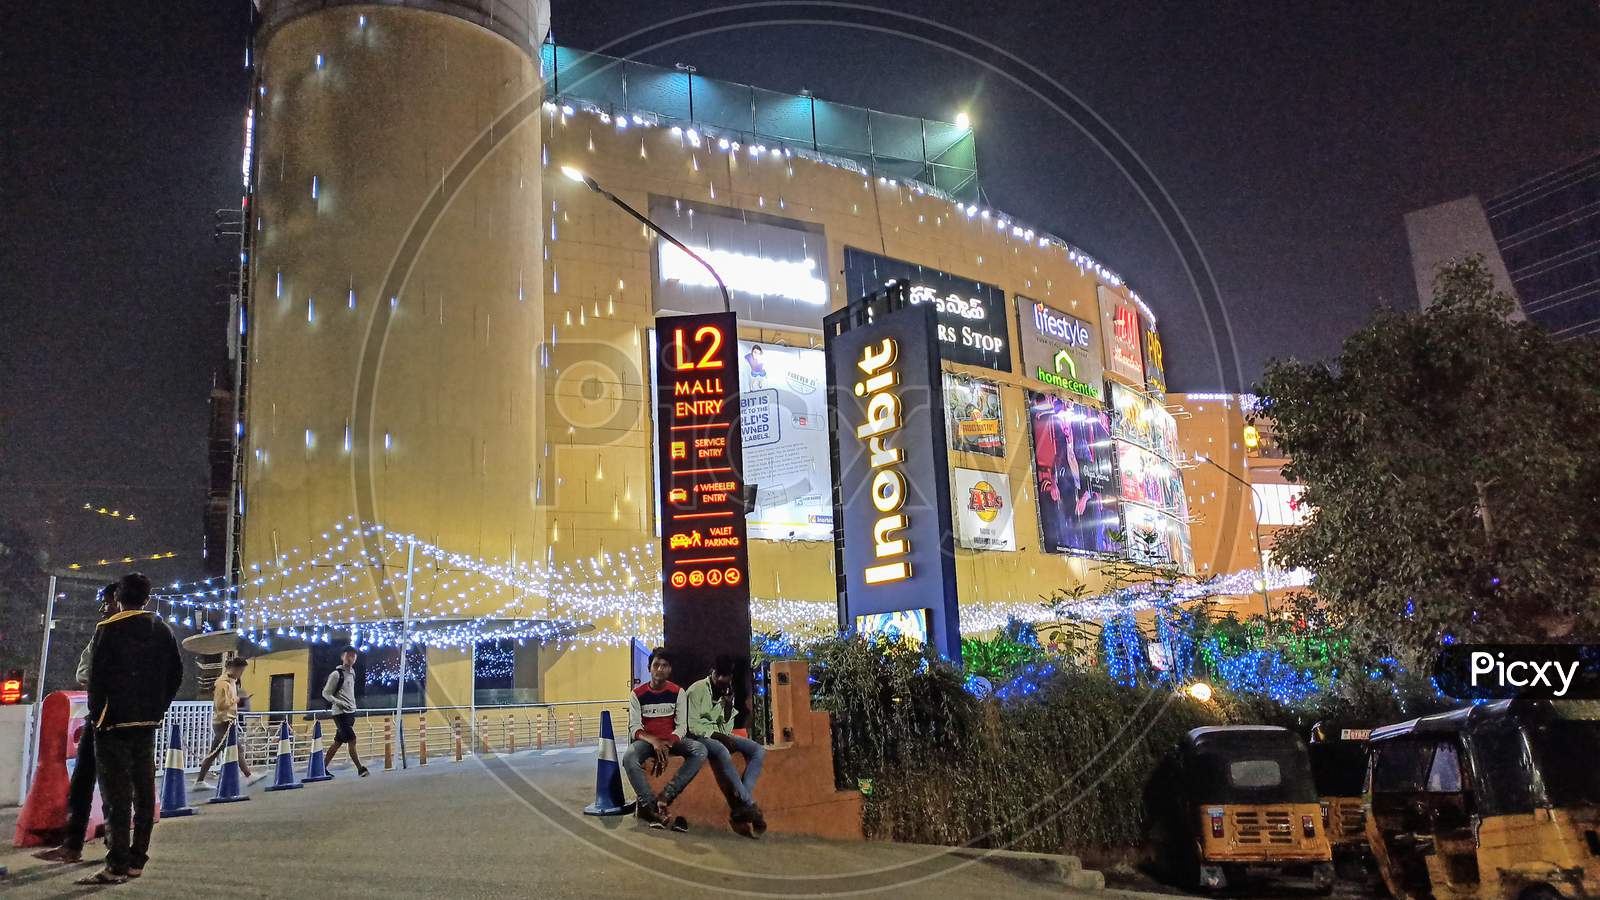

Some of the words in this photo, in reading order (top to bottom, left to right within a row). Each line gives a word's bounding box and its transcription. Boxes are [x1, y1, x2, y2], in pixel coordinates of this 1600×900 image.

[1032, 302, 1089, 347] lifestyle
[937, 324, 957, 343] RS
[961, 325, 1003, 353] STOP
[674, 326, 723, 370] L2
[674, 378, 723, 396] MALL
[1037, 366, 1099, 398] homecentre
[759, 396, 768, 405] IS
[675, 399, 723, 417] ENTRY
[748, 407, 756, 415] TO
[757, 405, 768, 413] THE
[694, 437, 726, 448] SERVICE
[699, 448, 723, 458] ENTRY
[857, 337, 909, 585] Inorbit
[693, 484, 699, 493] 4
[700, 481, 736, 492] WHEELER
[702, 492, 727, 503] ENTRY
[709, 526, 733, 537] VALET
[704, 537, 739, 548] PARKING
[674, 575, 684, 584] 10
